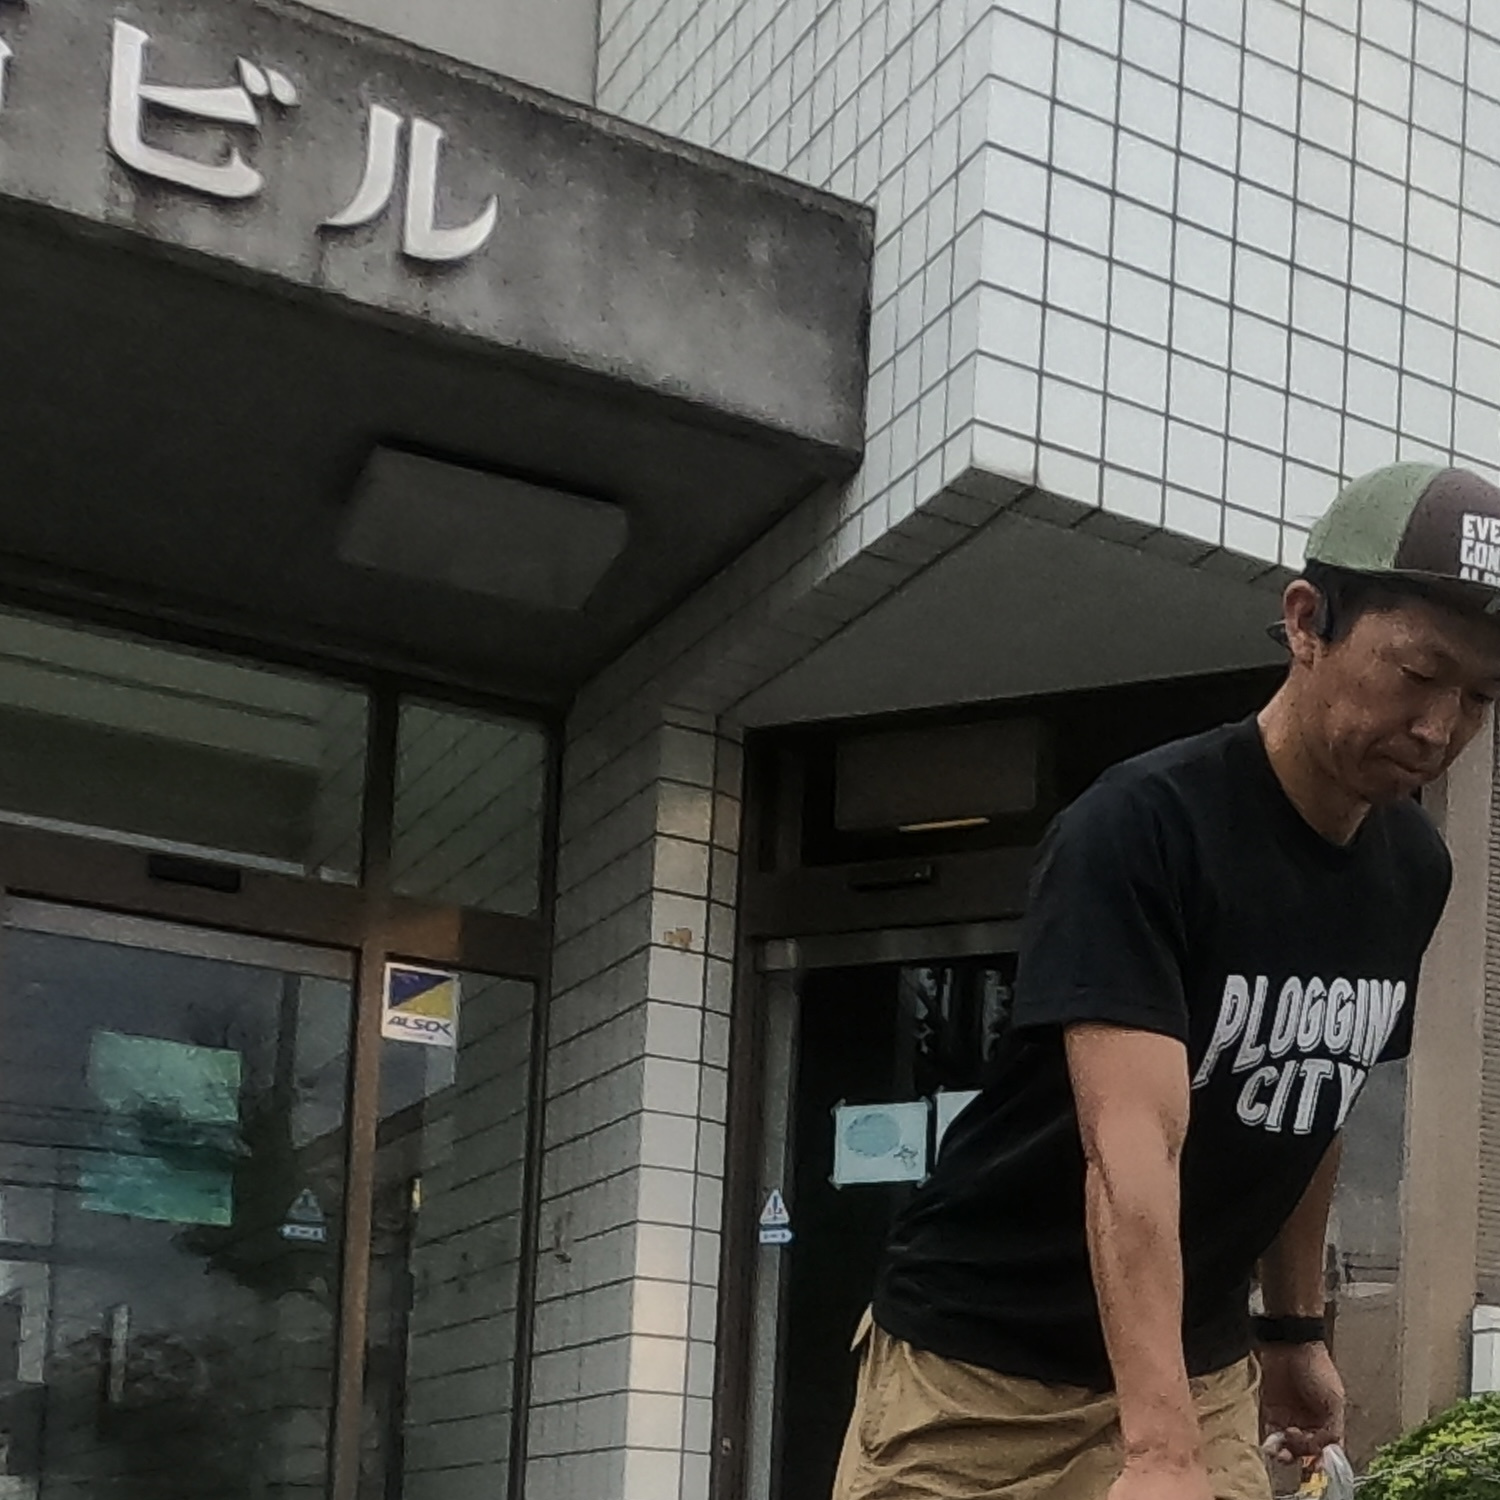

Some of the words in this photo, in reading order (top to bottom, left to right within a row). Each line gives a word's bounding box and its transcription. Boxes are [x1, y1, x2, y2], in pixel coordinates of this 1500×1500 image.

[0, 20, 499, 262] ビル
[387, 1016, 453, 1038] ALSOK
[1236, 1057, 1367, 1135] CITY
